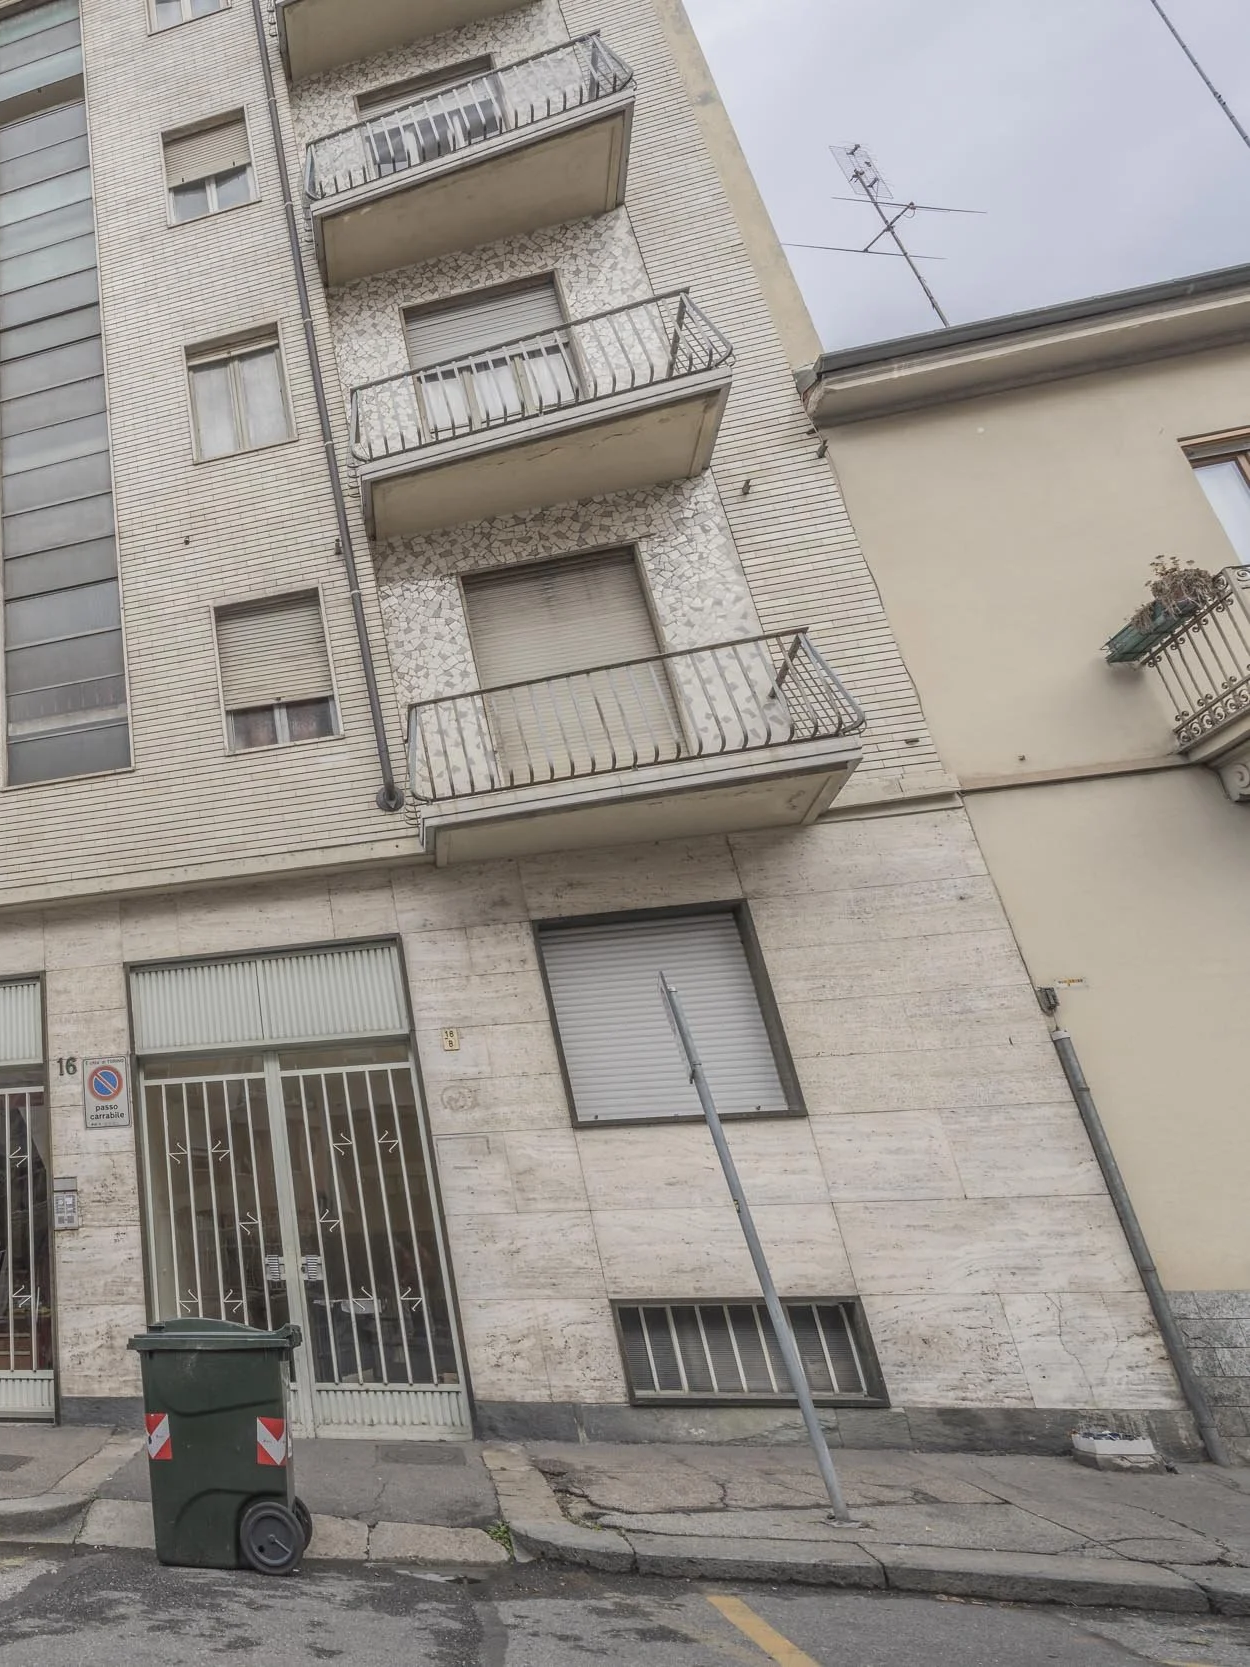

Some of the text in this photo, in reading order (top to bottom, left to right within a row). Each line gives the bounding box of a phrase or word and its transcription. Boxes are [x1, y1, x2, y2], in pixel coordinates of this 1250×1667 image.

[57, 1057, 77, 1076] 16
[95, 1104, 119, 1112] passo
[90, 1112, 125, 1120] carrabile
